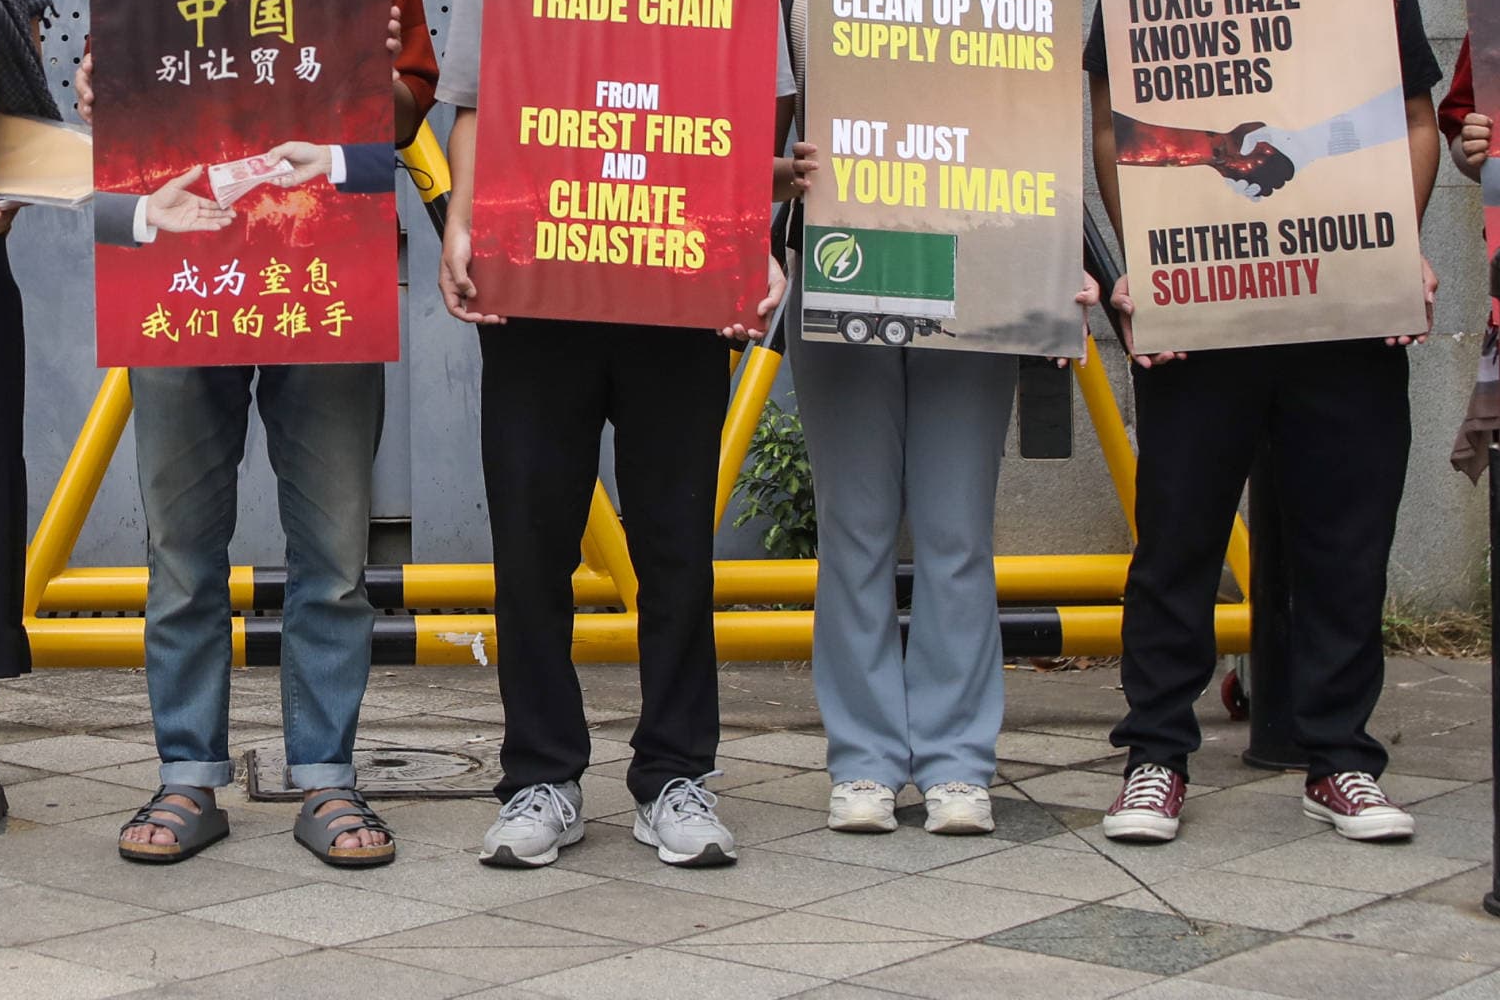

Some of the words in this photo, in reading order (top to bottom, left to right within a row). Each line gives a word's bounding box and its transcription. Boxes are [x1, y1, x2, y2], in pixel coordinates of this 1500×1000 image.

[832, 20, 940, 63] SUPPLY
[949, 29, 1055, 72] CHAINS
[1129, 19, 1241, 64] KNOWS
[1250, 15, 1293, 54] NO
[156, 45, 323, 86] 别让贸易
[1133, 58, 1273, 104] BORDERS
[595, 80, 660, 111] FROM
[519, 106, 637, 152] FOREST
[644, 115, 732, 157] FIRES
[832, 118, 888, 157] NOT
[896, 124, 970, 163] JUST
[600, 151, 647, 182] AND
[831, 157, 927, 208] YOUR
[939, 165, 1056, 217] IMAGE
[548, 179, 687, 225] CLIMATE
[535, 221, 706, 270] DISASTERS
[1148, 221, 1269, 266] NEITHER
[1277, 212, 1395, 256] SHOULD
[167, 256, 339, 298] 成为窒息
[1151, 258, 1320, 307] SOLIDARITY
[141, 300, 354, 343] 我们的推手
